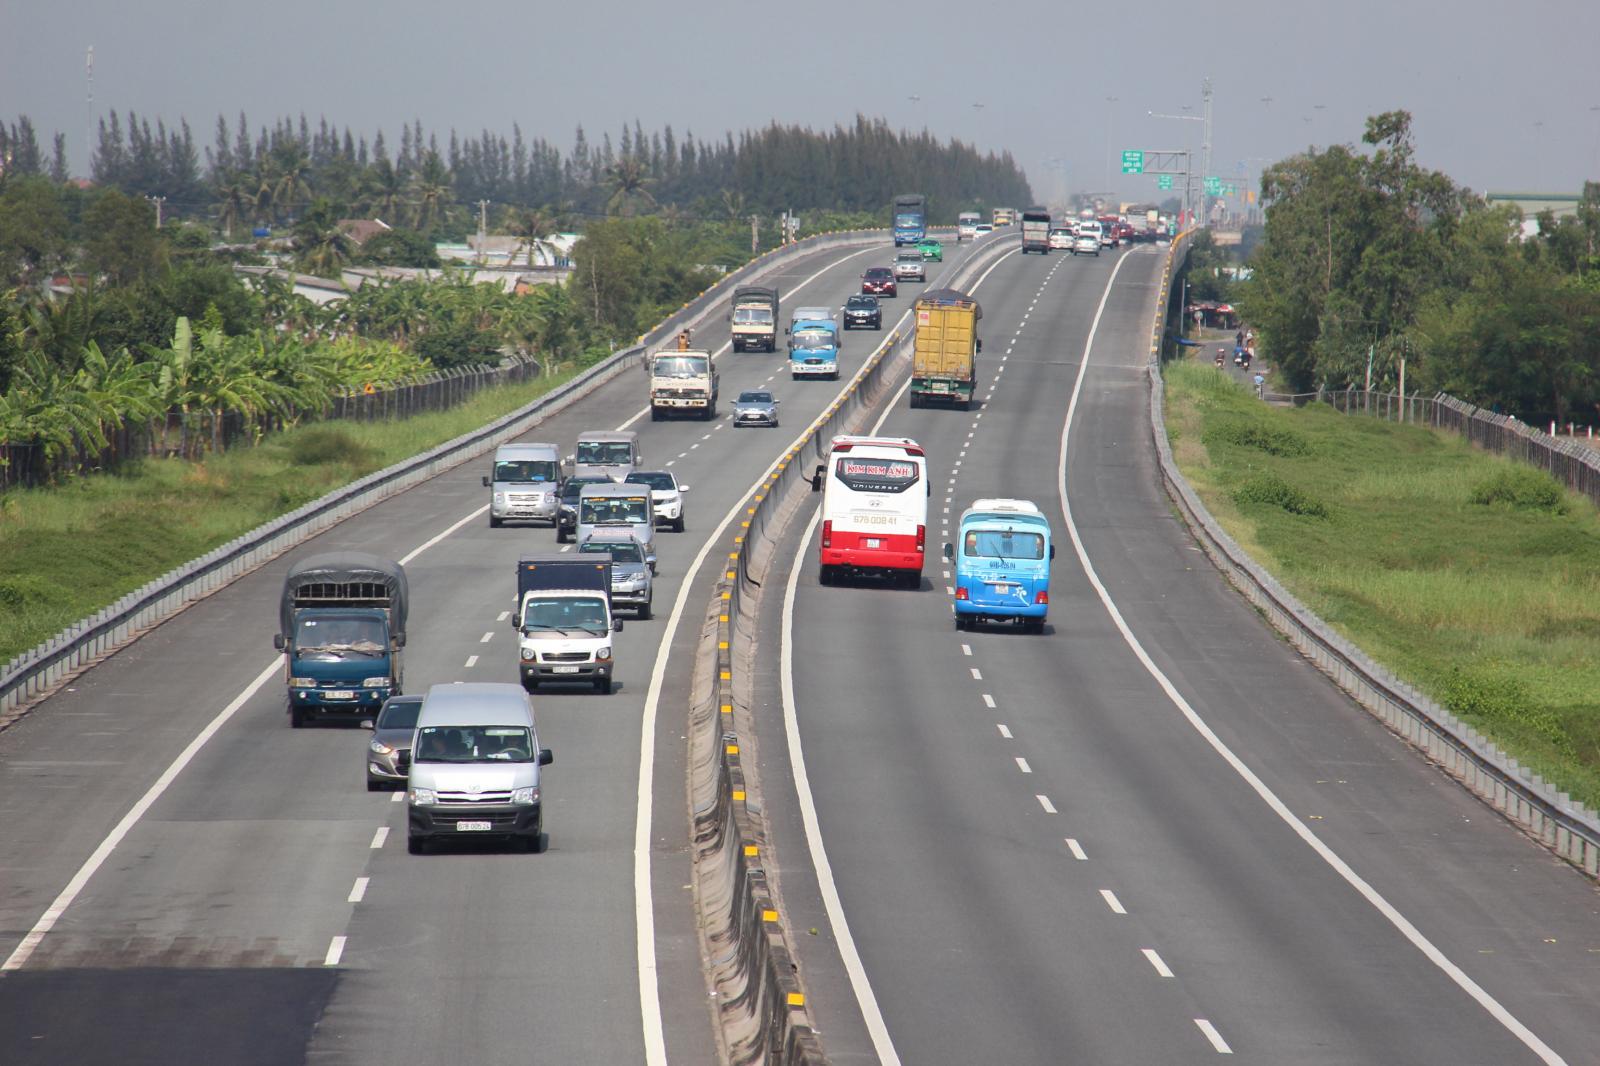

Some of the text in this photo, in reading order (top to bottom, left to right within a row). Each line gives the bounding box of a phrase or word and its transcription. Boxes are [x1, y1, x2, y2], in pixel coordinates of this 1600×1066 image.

[847, 464, 909, 476] KIM KIM ANH
